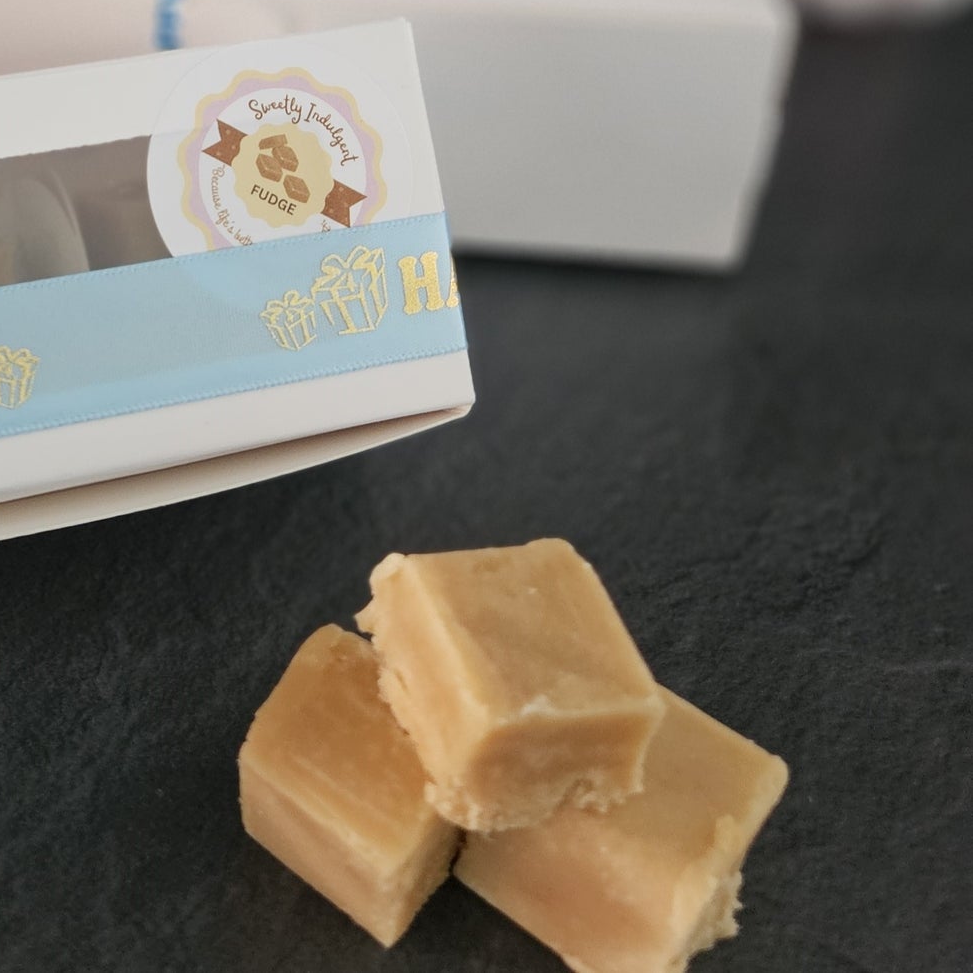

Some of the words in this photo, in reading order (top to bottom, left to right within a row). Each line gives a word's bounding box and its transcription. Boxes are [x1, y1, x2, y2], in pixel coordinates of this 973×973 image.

[248, 94, 302, 125] Sweetly
[303, 102, 359, 167] Indulgent
[250, 184, 297, 216] FUDGE
